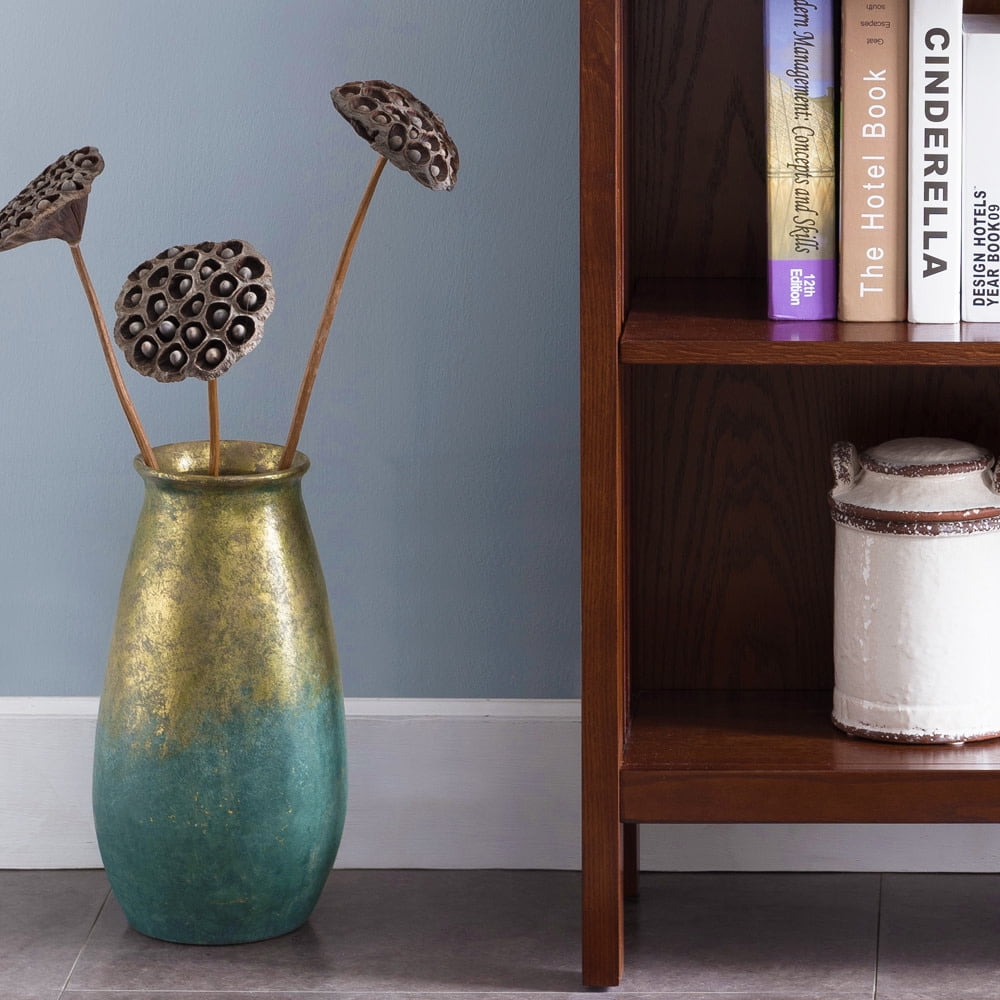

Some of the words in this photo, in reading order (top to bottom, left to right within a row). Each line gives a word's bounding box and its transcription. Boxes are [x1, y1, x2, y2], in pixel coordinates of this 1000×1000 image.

[860, 20, 891, 29] Escapes
[785, 31, 816, 120] Management:
[862, 69, 887, 138] Book
[786, 125, 815, 185] Concepts
[922, 27, 951, 278] CINDERELLA
[794, 187, 819, 216] and
[860, 155, 886, 230] Hotel
[788, 216, 819, 254] Skills
[987, 204, 1000, 263] BOOK09
[790, 268, 803, 306] Edition
[803, 274, 816, 298] 12th
[859, 247, 885, 298] The
[972, 253, 986, 306] DESIGN
[986, 268, 1000, 307] YEAR
